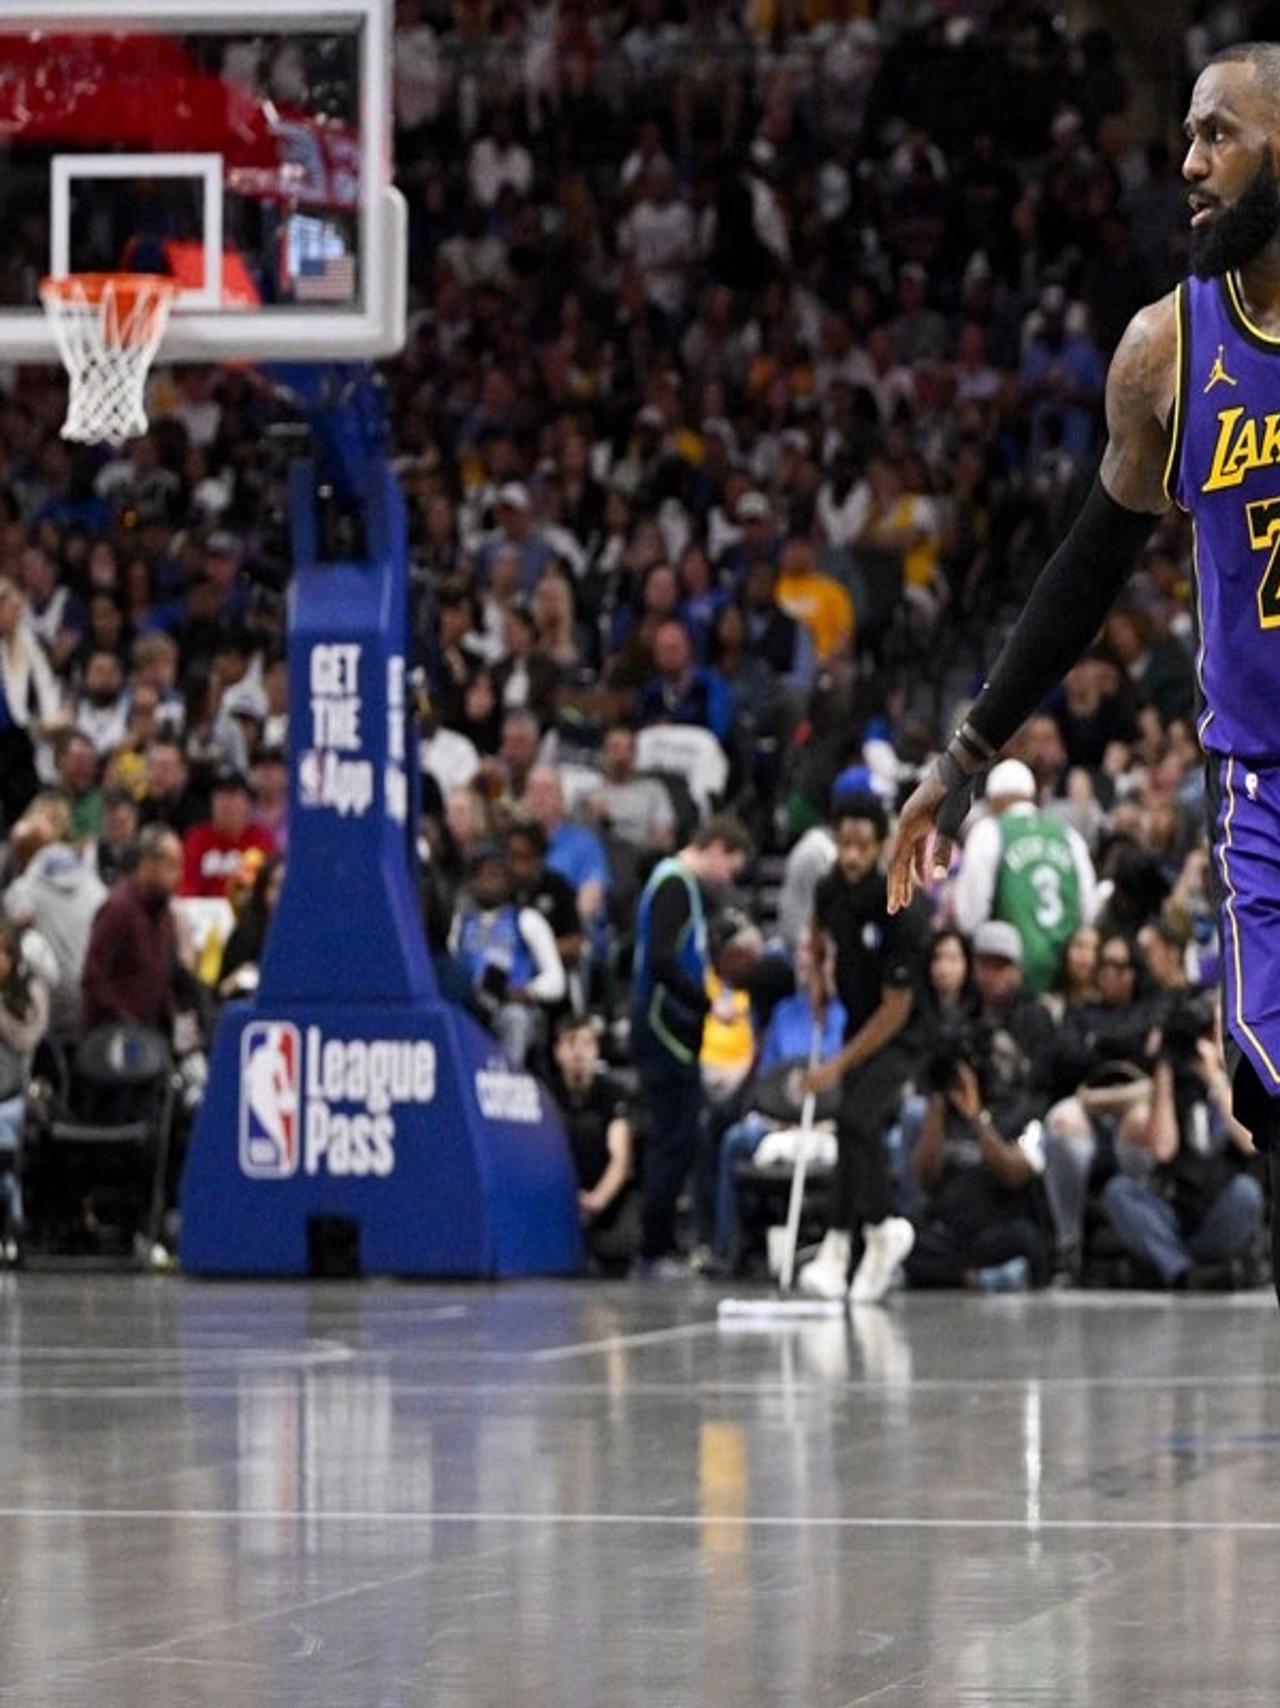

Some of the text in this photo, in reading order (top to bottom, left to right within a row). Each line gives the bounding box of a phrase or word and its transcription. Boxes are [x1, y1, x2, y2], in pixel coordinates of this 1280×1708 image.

[310, 643, 361, 694] GET
[310, 696, 361, 750] THE
[1031, 865, 1064, 928] 3
[305, 1025, 437, 1115] League
[305, 1100, 395, 1177] Pass
